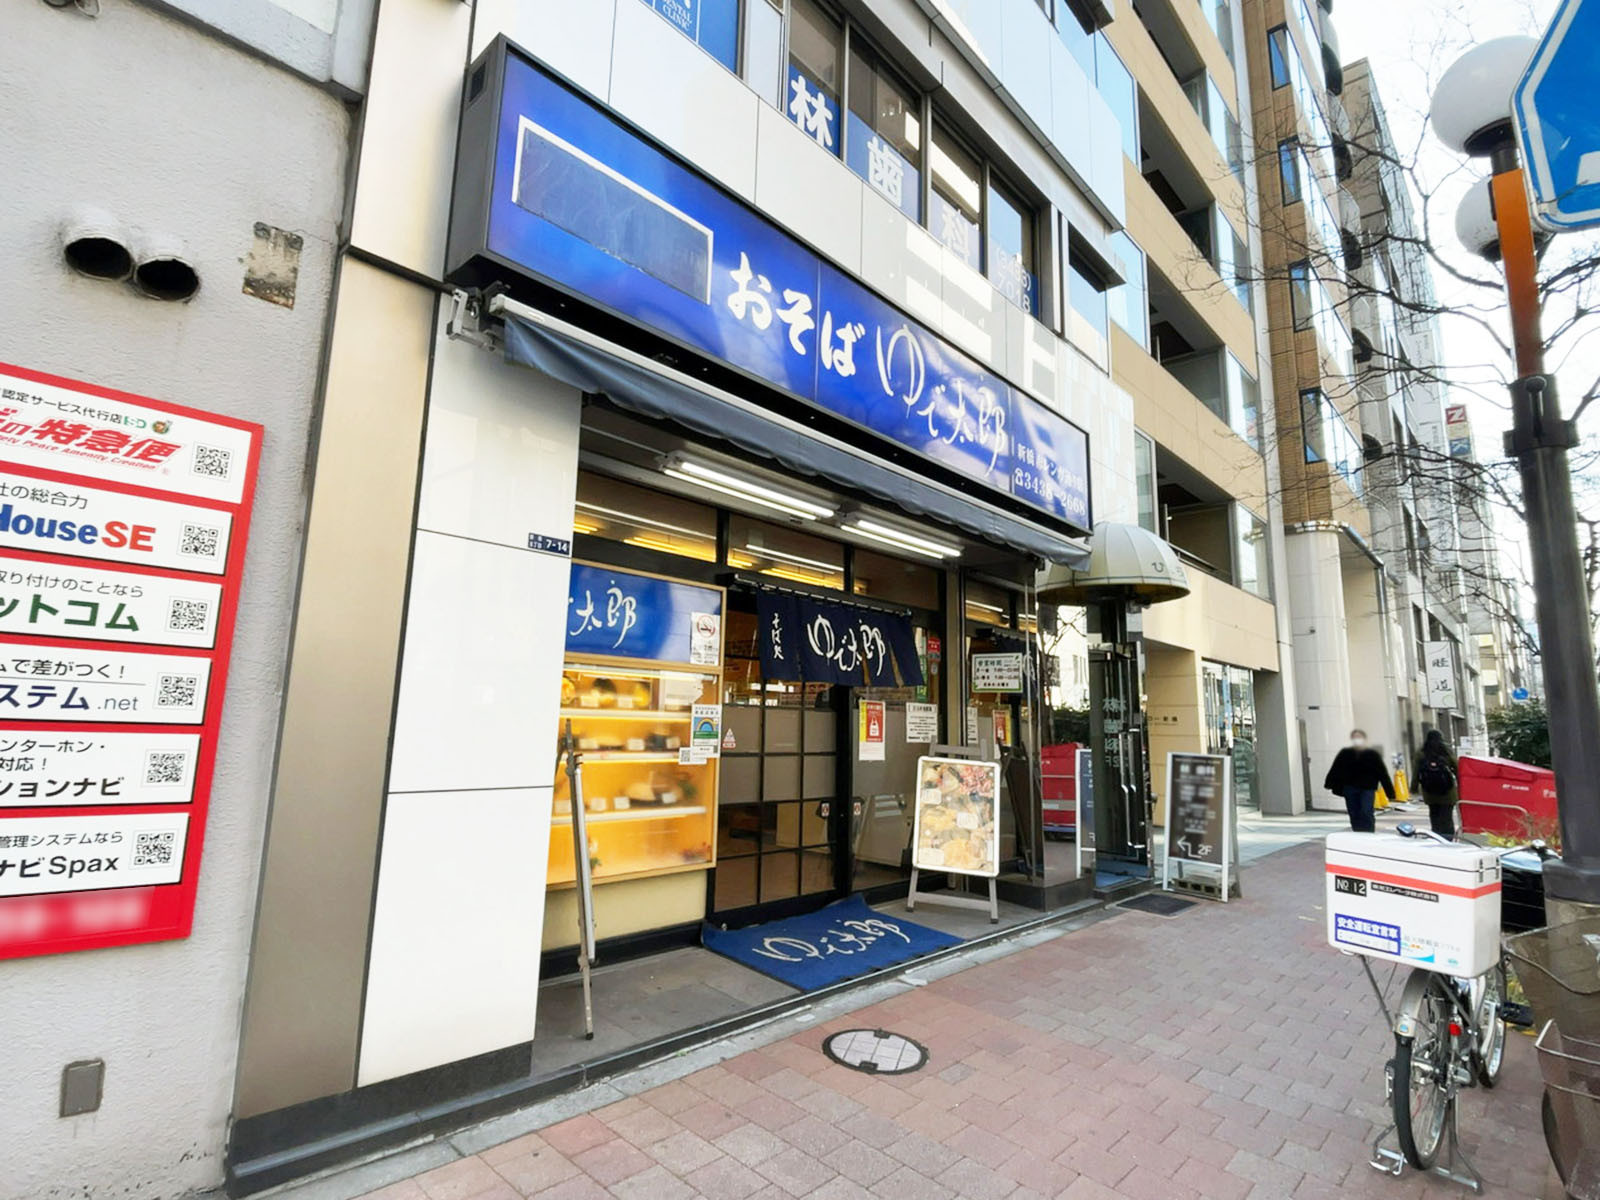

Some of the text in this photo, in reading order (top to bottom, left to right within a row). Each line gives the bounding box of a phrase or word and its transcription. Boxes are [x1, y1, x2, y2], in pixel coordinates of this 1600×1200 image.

[791, 75, 834, 147] 林
[867, 136, 904, 207] 歯
[727, 251, 1006, 478] おそば ゆで太郎
[546, 538, 568, 553] 7-14
[806, 613, 886, 677] ゆで太郎
[1197, 843, 1213, 856] 2F
[752, 918, 911, 962] ゆで太郎
